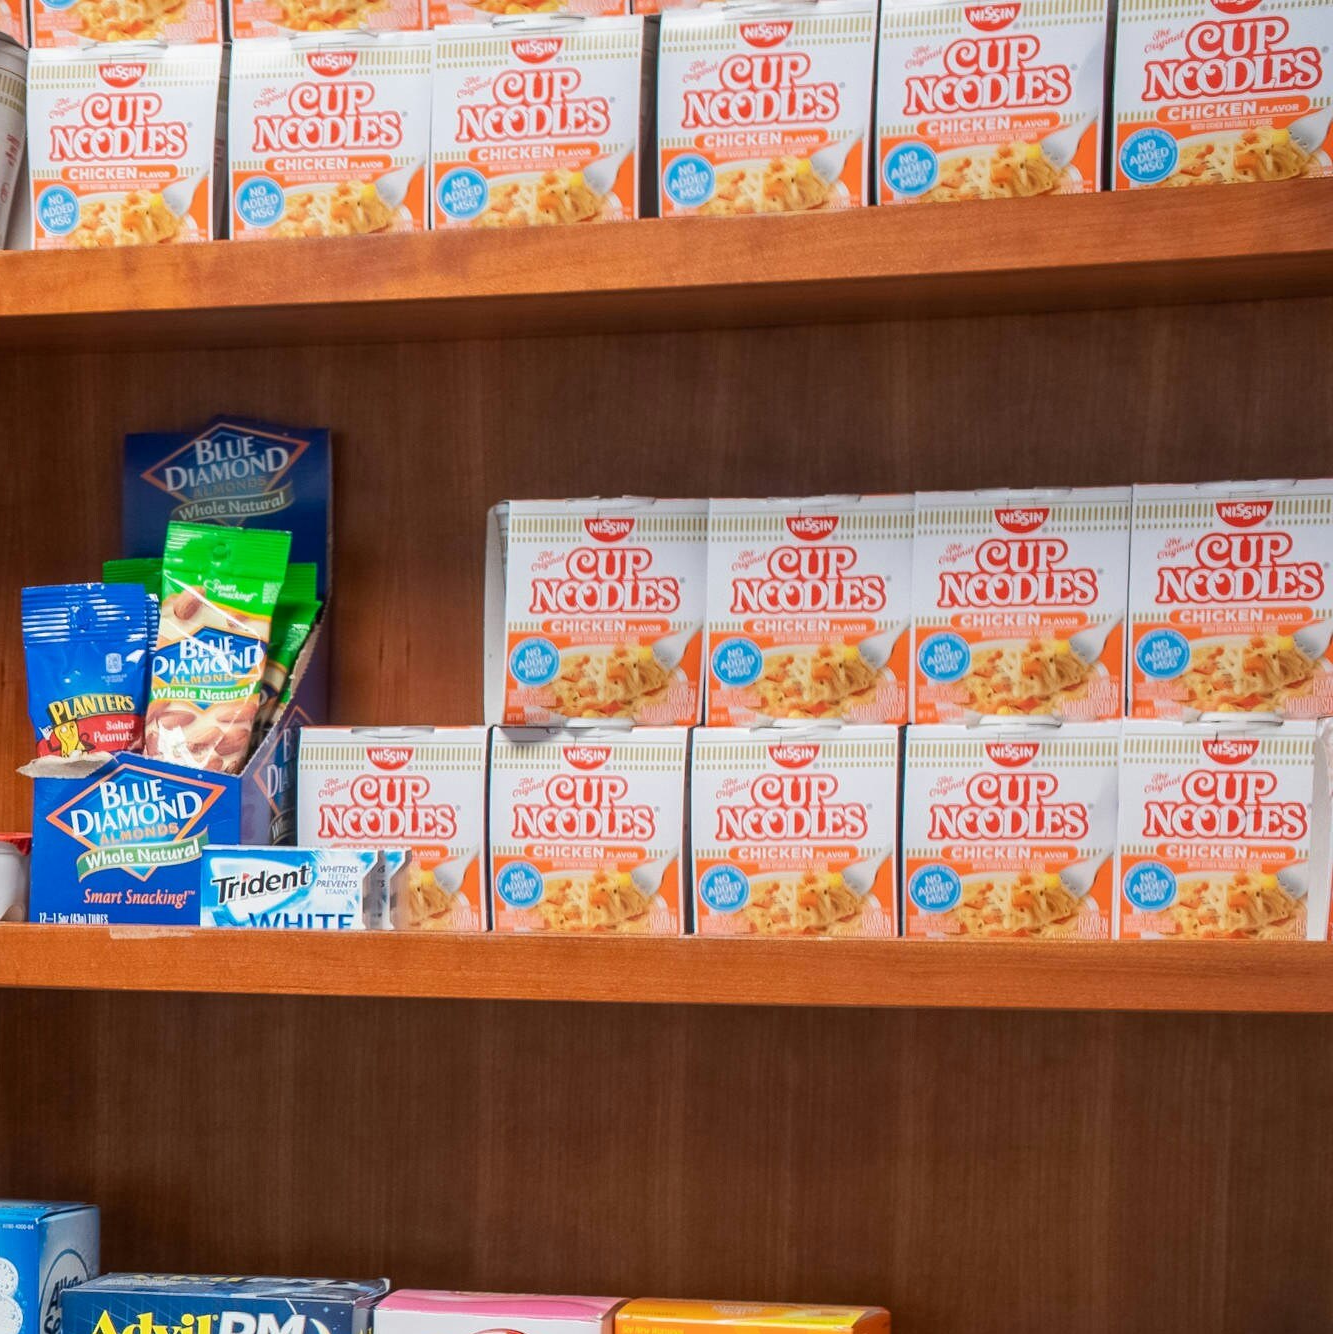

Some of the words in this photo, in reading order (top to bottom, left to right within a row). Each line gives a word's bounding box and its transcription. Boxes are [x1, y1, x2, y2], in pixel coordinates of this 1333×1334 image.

[745, 24, 788, 40] NISSIN
[1185, 16, 1288, 59] CUP
[103, 65, 144, 80] NISSIN
[718, 52, 811, 88] CUP
[1142, 51, 1322, 101] NOODLES
[288, 82, 375, 116] CUP
[682, 84, 839, 128] NOODLES
[1168, 102, 1256, 119] CHICKEN
[253, 112, 402, 151] NOODLES
[1137, 139, 1156, 153] NO
[477, 146, 554, 160] CHICKEN
[1129, 148, 1169, 164] ADDED
[69, 167, 138, 181] CHICKEN
[195, 437, 254, 465] BLUE
[165, 448, 288, 492] DIAMOND
[180, 503, 226, 521] Whole
[229, 493, 284, 513] Natural
[1000, 511, 1043, 525] NISSIN
[767, 546, 856, 580] CUP
[975, 539, 1068, 573] CUP
[730, 576, 886, 614] NOODLES
[937, 569, 1098, 608] NOODLES
[1180, 610, 1263, 622] CHICKEN
[152, 646, 263, 677] DIAMOND
[183, 636, 234, 658] BLUE
[152, 686, 195, 699] Whole
[200, 683, 254, 699] Natural
[49, 695, 135, 724] PLANTERS
[371, 750, 409, 761] NISSIN
[1208, 743, 1252, 755] NISSIN
[99, 780, 165, 805] BLUE
[350, 775, 430, 806] CUP
[751, 774, 838, 807] CUP
[1182, 771, 1277, 805] CUP
[71, 791, 202, 834] DIAMOND
[318, 805, 457, 840] NOODLES
[715, 803, 868, 840] NOODLES
[1143, 801, 1307, 840] NOODLES
[100, 823, 179, 843] ALMONDS
[85, 849, 133, 866] Whole
[138, 840, 200, 862] Natural
[1167, 846, 1247, 858] CHICKEN
[84, 888, 125, 905] Smart
[211, 864, 310, 903] Trident
